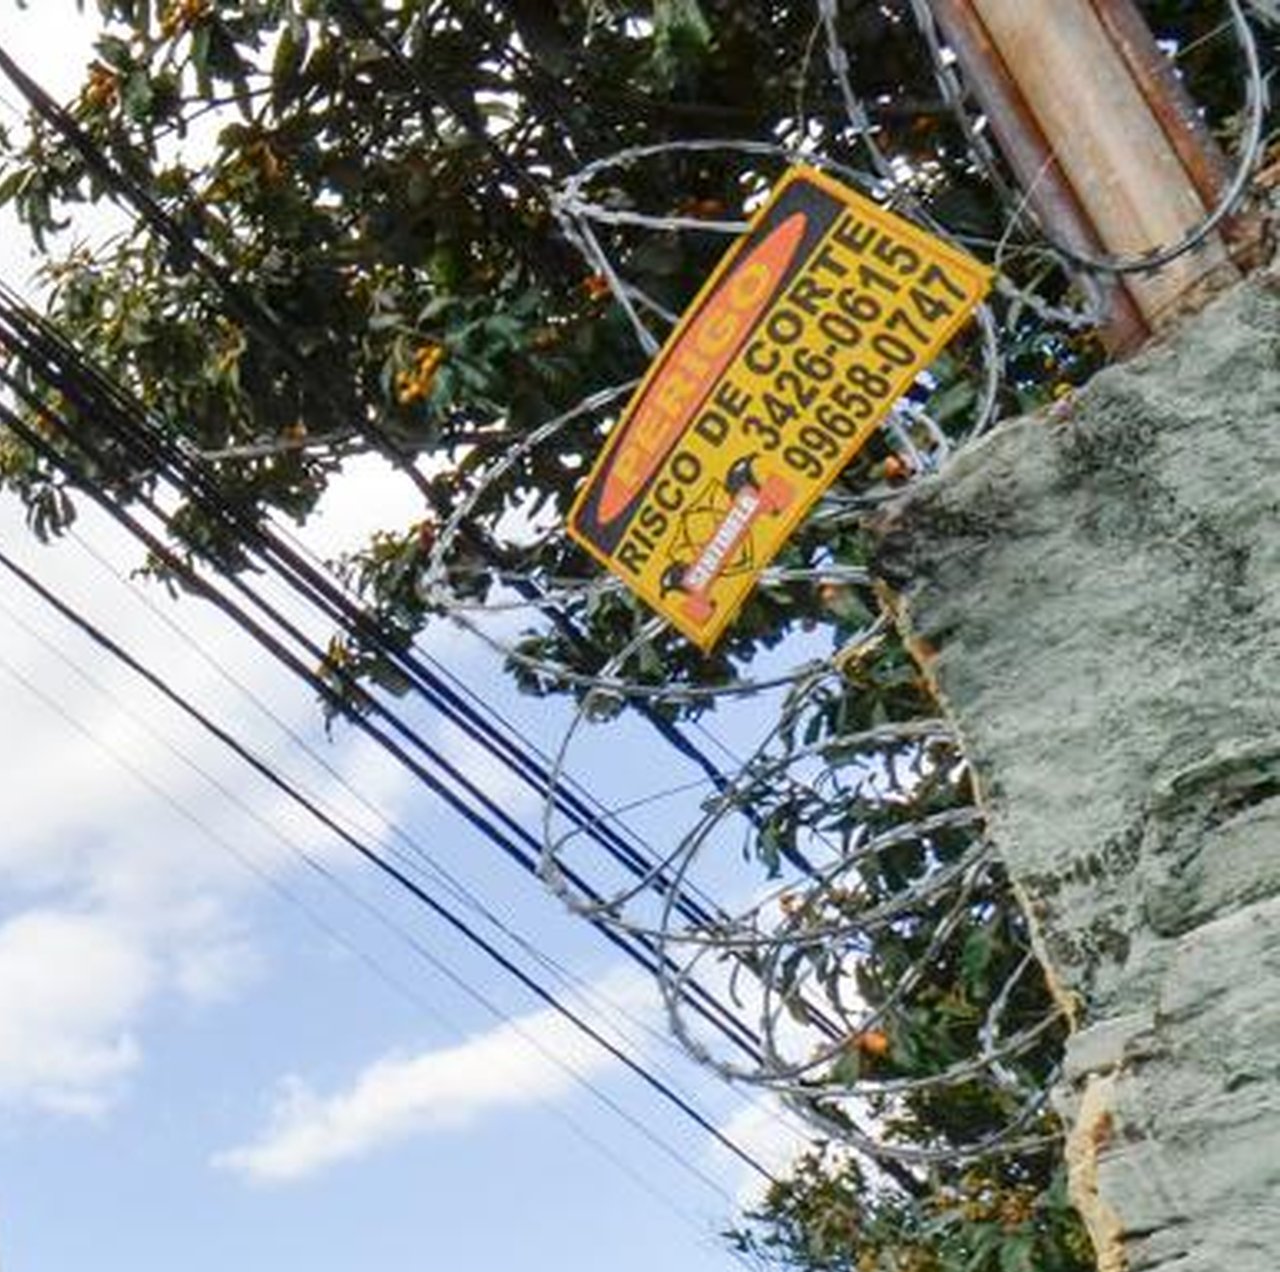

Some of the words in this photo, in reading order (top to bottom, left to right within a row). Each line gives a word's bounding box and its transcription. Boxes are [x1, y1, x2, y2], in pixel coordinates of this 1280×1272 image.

[612, 264, 766, 480] PERIGO
[617, 451, 702, 576] RISCO
[696, 384, 751, 448] DE
[746, 214, 872, 377] CORTE
[742, 240, 922, 451] 3426-0615
[783, 266, 967, 479] 99658-0747
